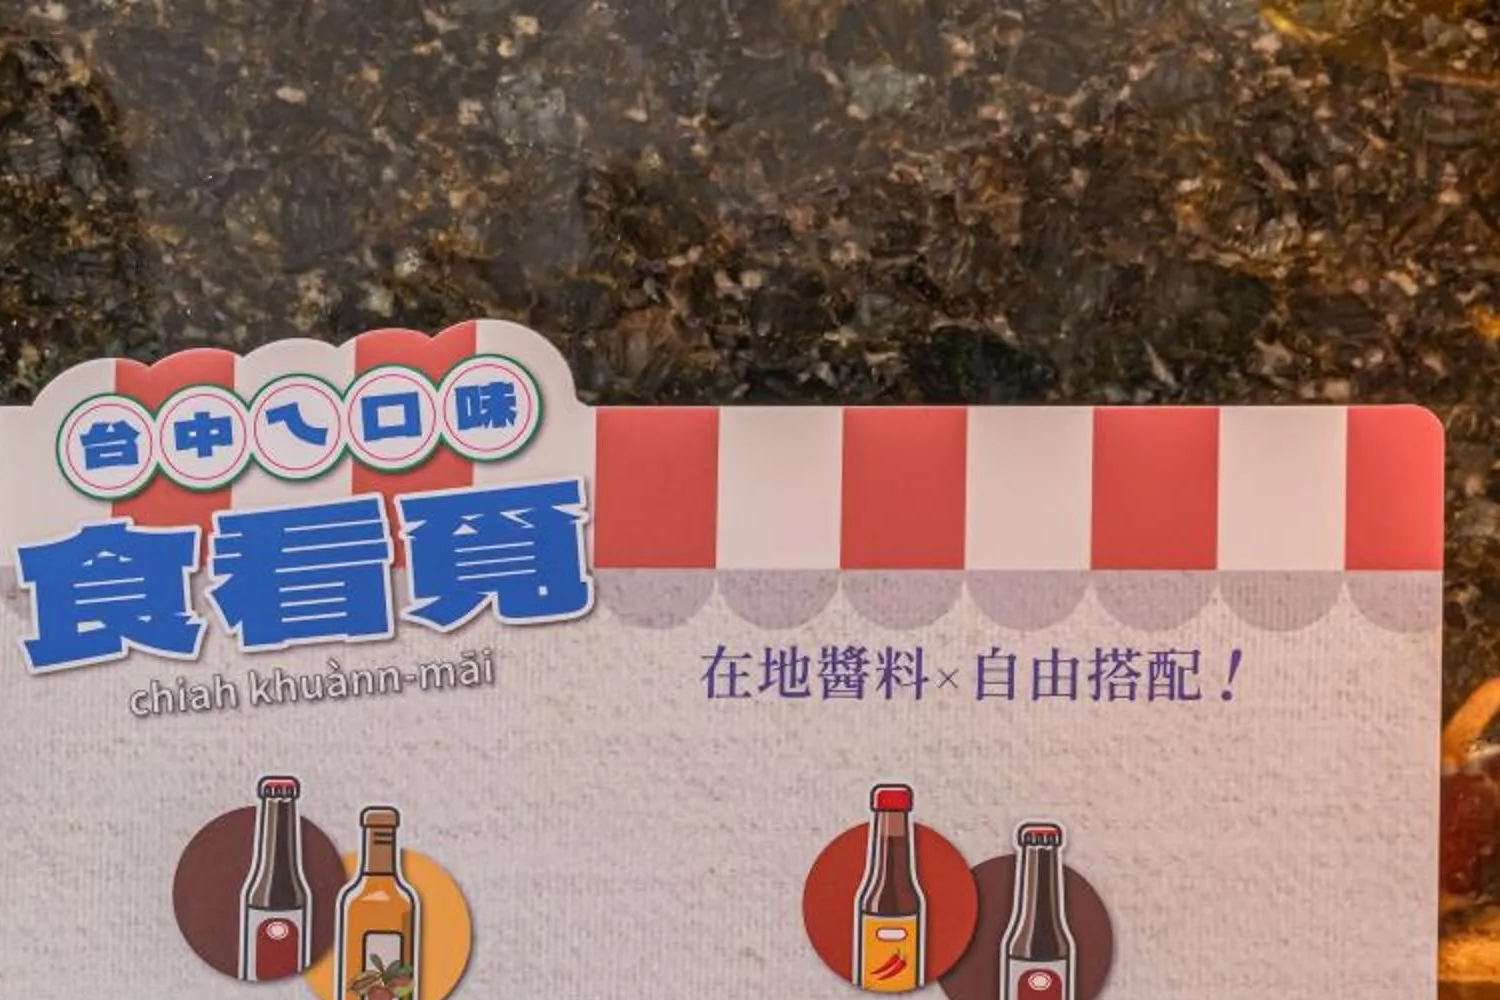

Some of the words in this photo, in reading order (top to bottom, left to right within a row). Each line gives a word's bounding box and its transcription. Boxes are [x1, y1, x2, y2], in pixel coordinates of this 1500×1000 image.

[16, 479, 591, 669] 食看覓
[129, 666, 238, 716] chiah
